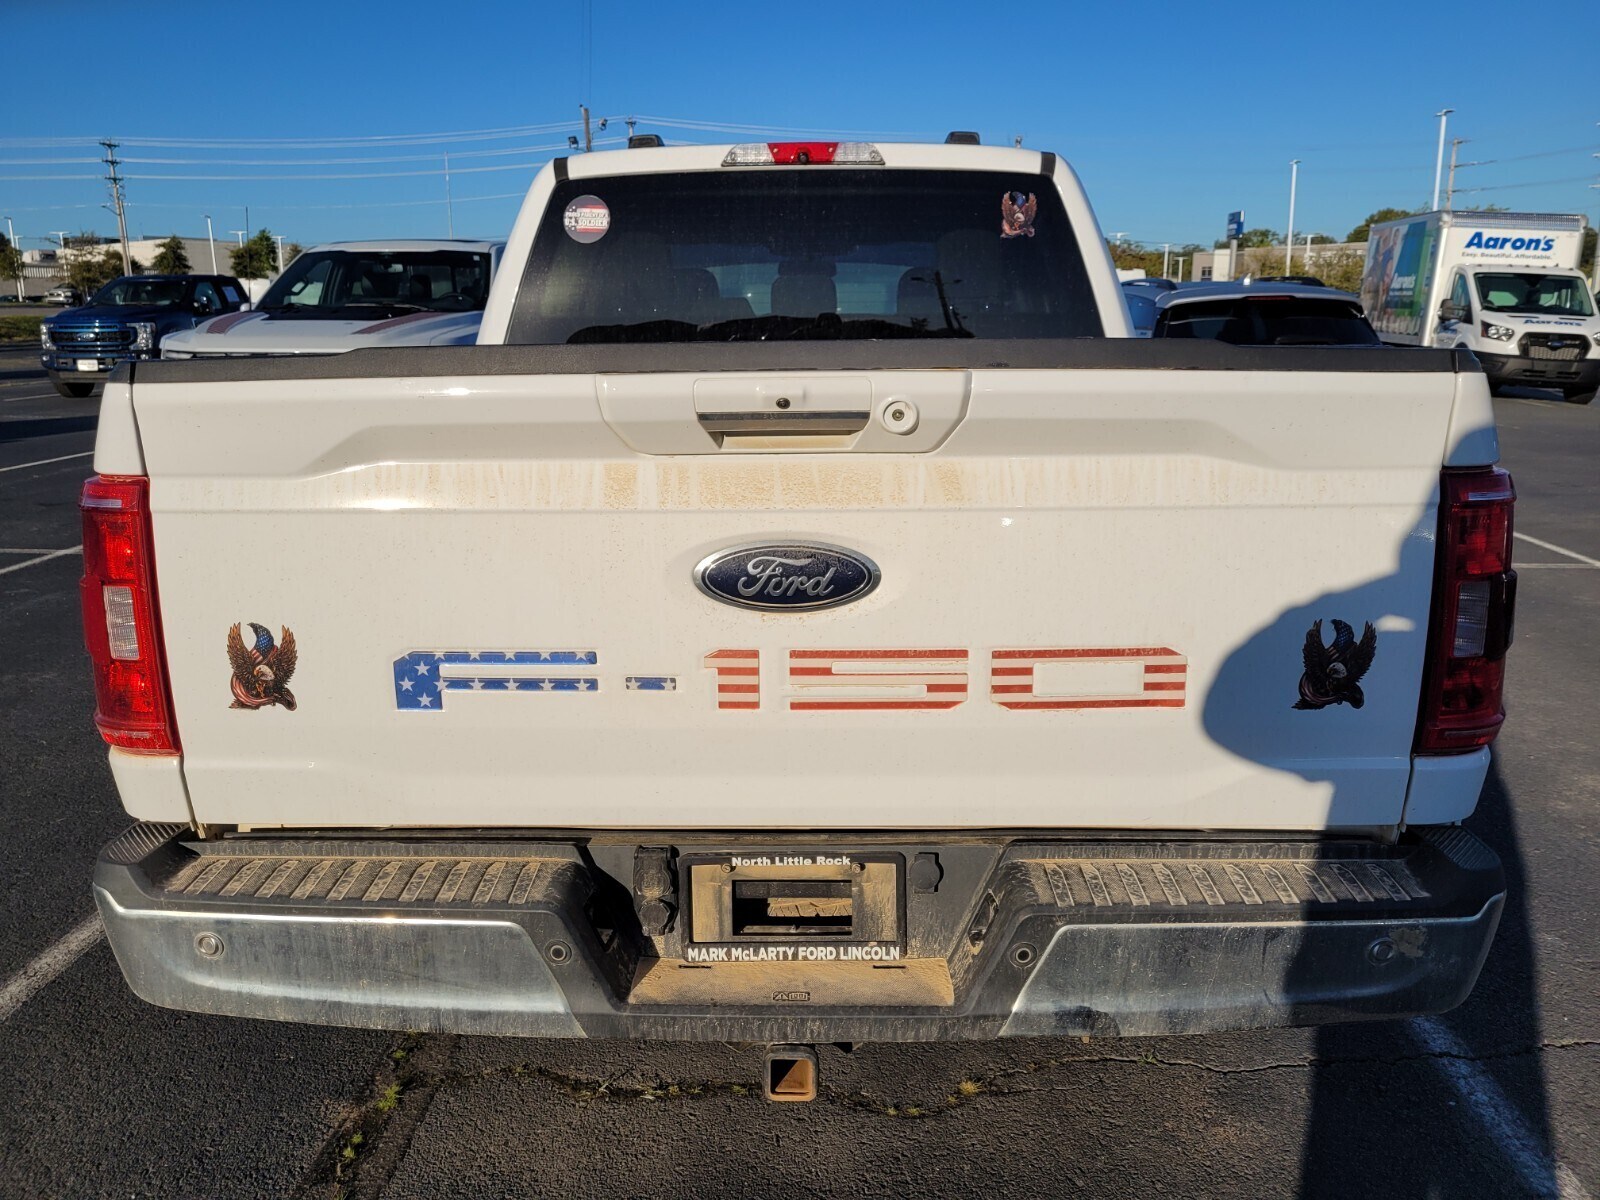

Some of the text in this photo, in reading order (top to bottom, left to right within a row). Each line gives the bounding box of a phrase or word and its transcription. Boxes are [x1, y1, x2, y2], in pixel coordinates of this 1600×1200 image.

[565, 218, 609, 227] U.S. SOLDIER
[1464, 231, 1556, 251] Aaron's
[737, 556, 837, 597] Ford
[393, 646, 1188, 710] F-150
[731, 856, 851, 867] North Little Rock
[687, 946, 900, 961] MARK McLARTY FORD LINCOLN
